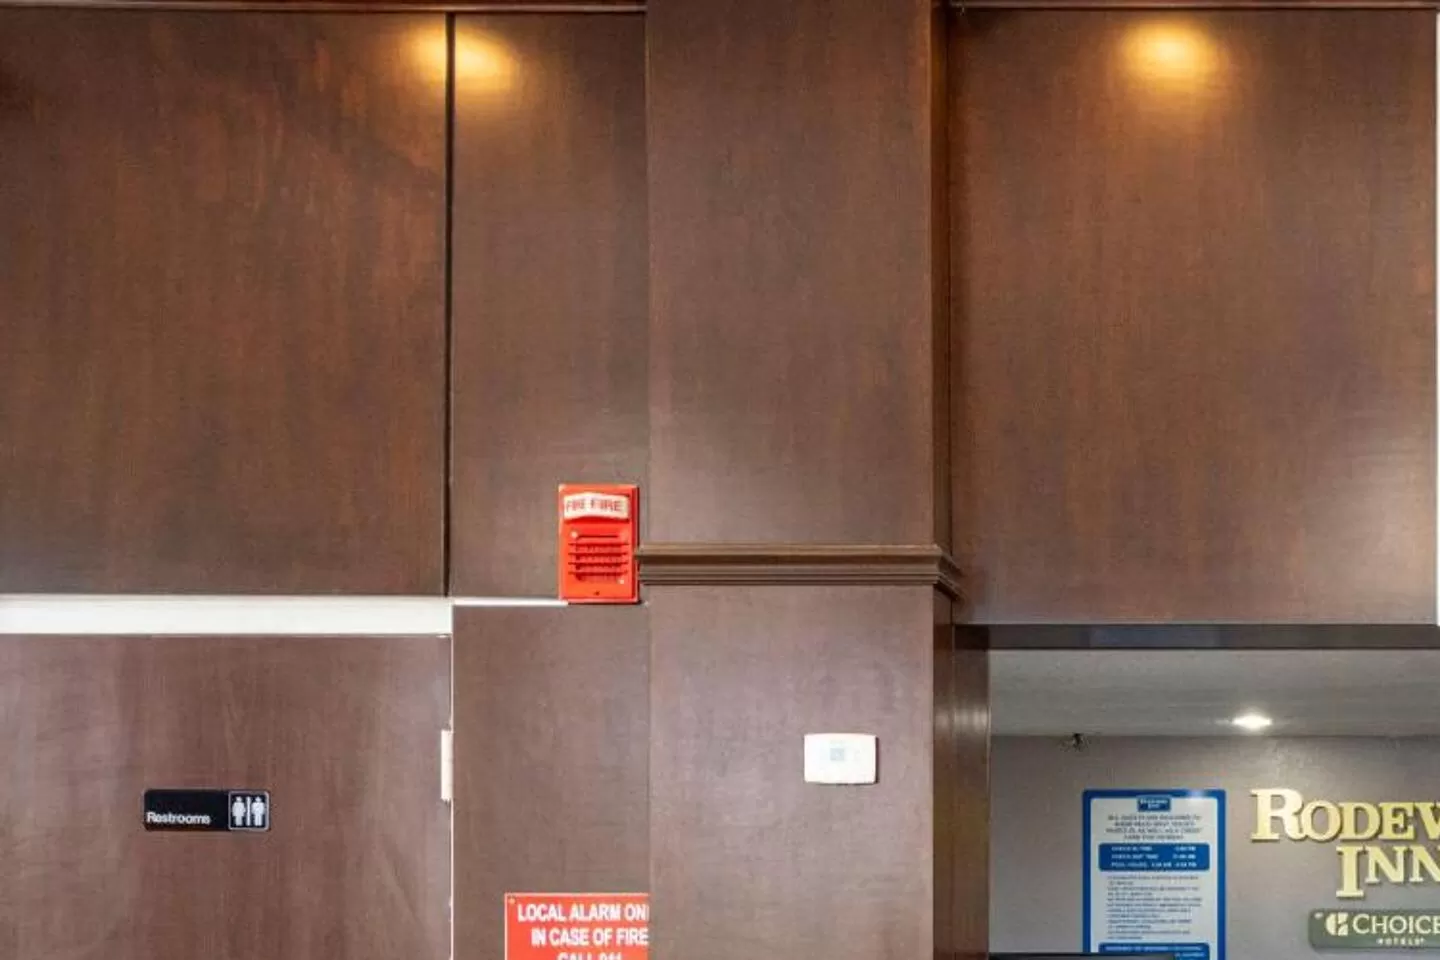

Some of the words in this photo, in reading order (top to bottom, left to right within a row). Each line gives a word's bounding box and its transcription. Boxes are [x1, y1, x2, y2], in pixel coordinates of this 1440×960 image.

[590, 498, 621, 512] FIRE
[146, 811, 211, 825] Restrooms
[517, 903, 567, 922] LOCAL
[569, 903, 621, 922] ALARM
[531, 927, 546, 945] IN
[549, 927, 590, 945] CASE
[592, 927, 613, 945] OF
[616, 927, 649, 945] FIRE
